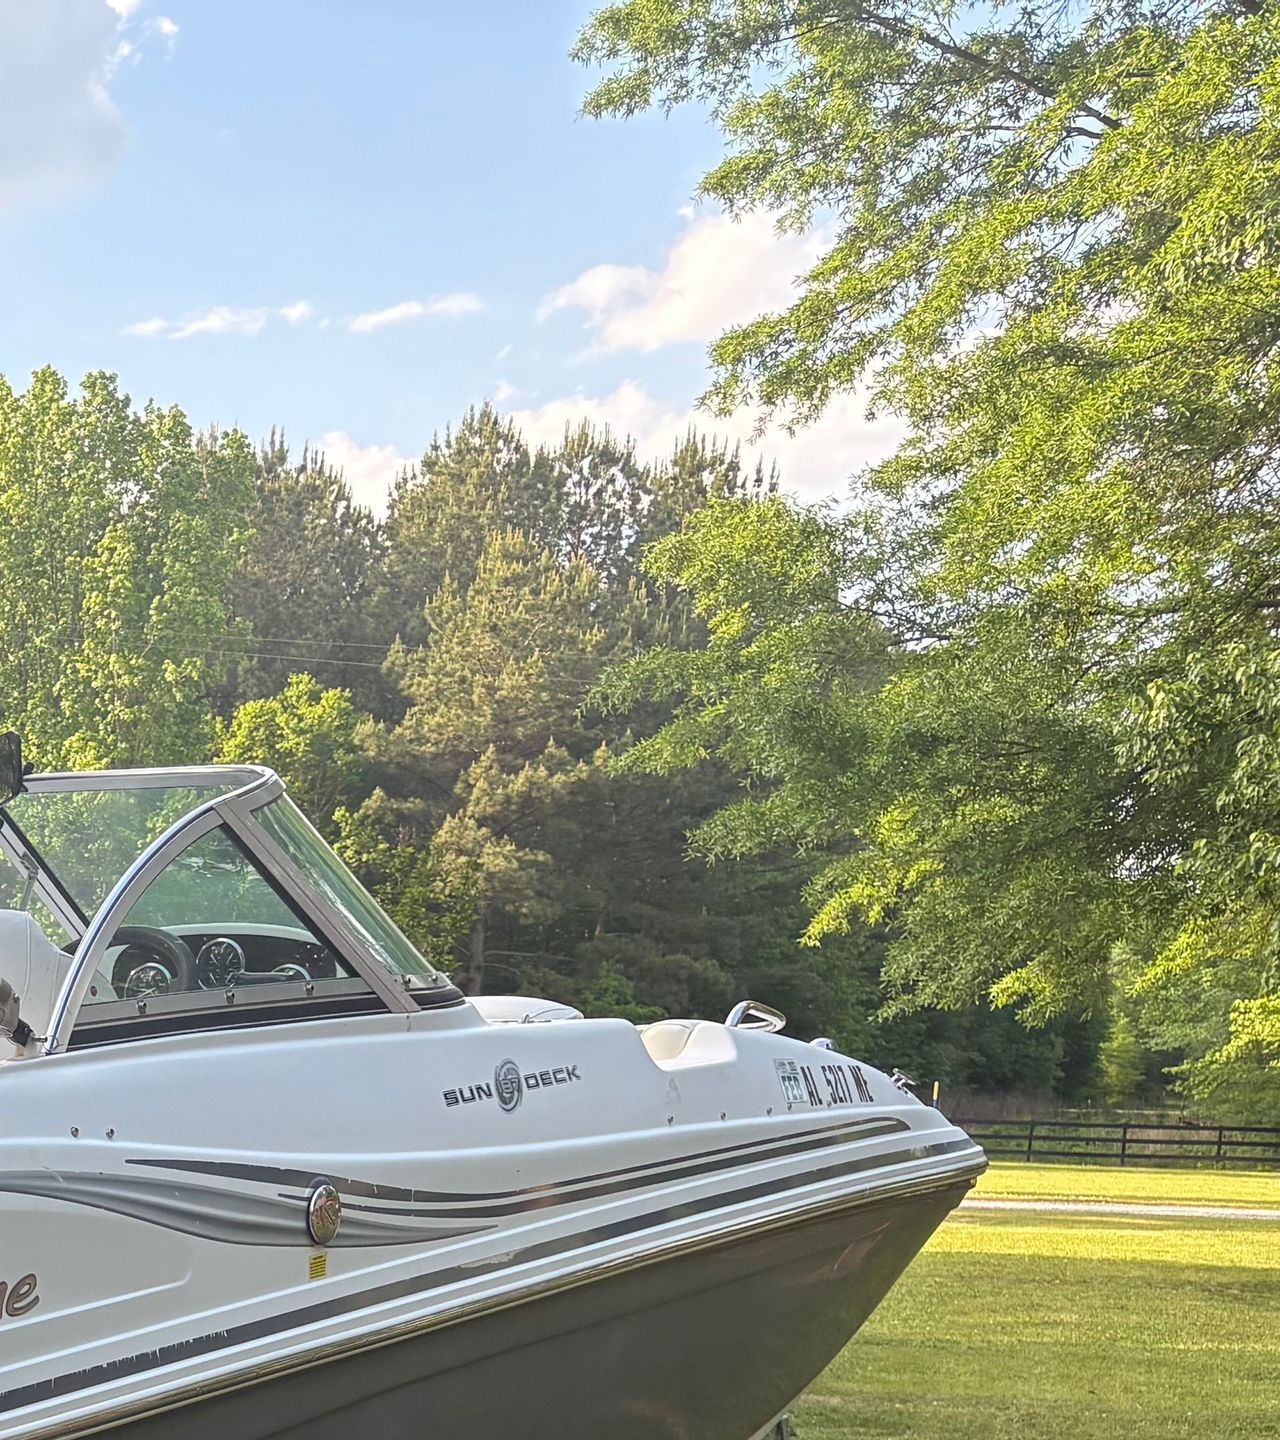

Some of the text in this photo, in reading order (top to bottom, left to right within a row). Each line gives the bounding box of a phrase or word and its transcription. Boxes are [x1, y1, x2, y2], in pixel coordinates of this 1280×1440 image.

[443, 1065, 581, 1107] SUN 187 DECK
[800, 1066, 823, 1106] AL
